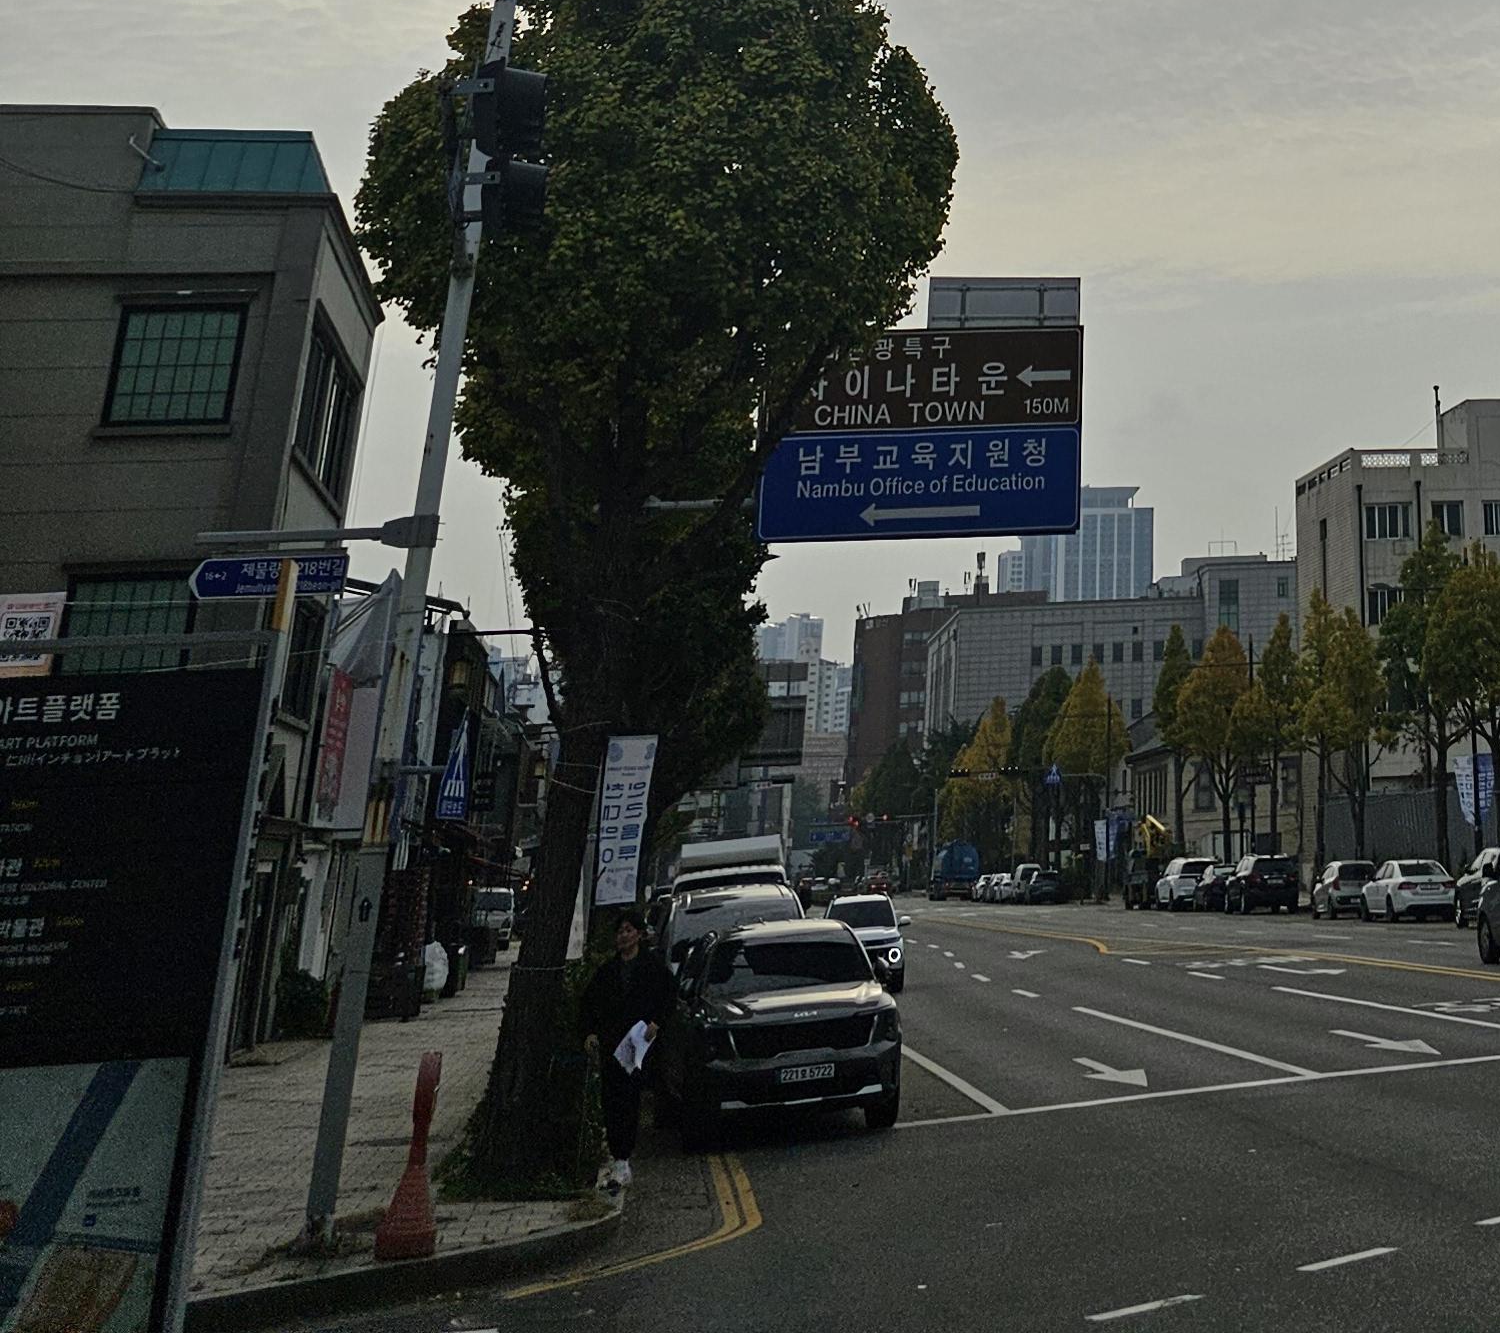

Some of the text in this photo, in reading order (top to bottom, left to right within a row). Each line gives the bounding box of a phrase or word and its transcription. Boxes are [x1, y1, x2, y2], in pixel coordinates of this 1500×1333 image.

[814, 397, 1070, 427] CHINA TOWN 150M
[797, 436, 1048, 477] 남부교육지원청
[796, 471, 1046, 501] Nambu Office of Education
[26, 732, 99, 749] PLATFORM
